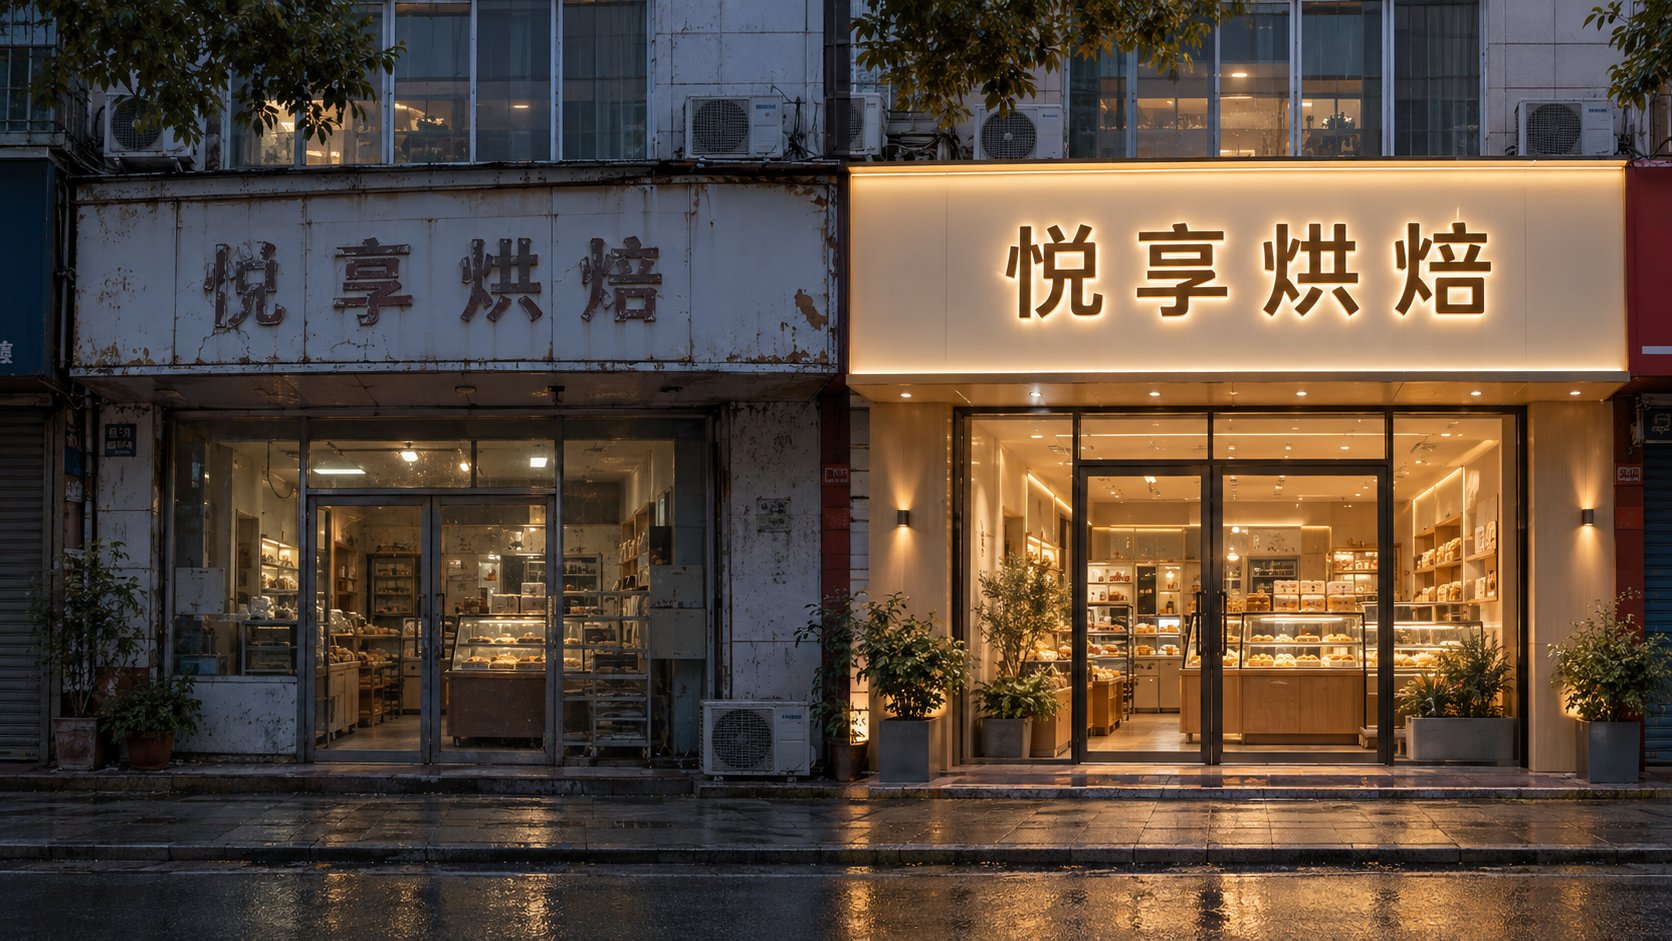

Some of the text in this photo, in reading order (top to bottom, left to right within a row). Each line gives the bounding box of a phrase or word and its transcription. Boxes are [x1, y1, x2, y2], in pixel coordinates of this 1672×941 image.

[204, 237, 663, 329] 悦享烘焙
[1005, 222, 1492, 318] 悦享烘焙
